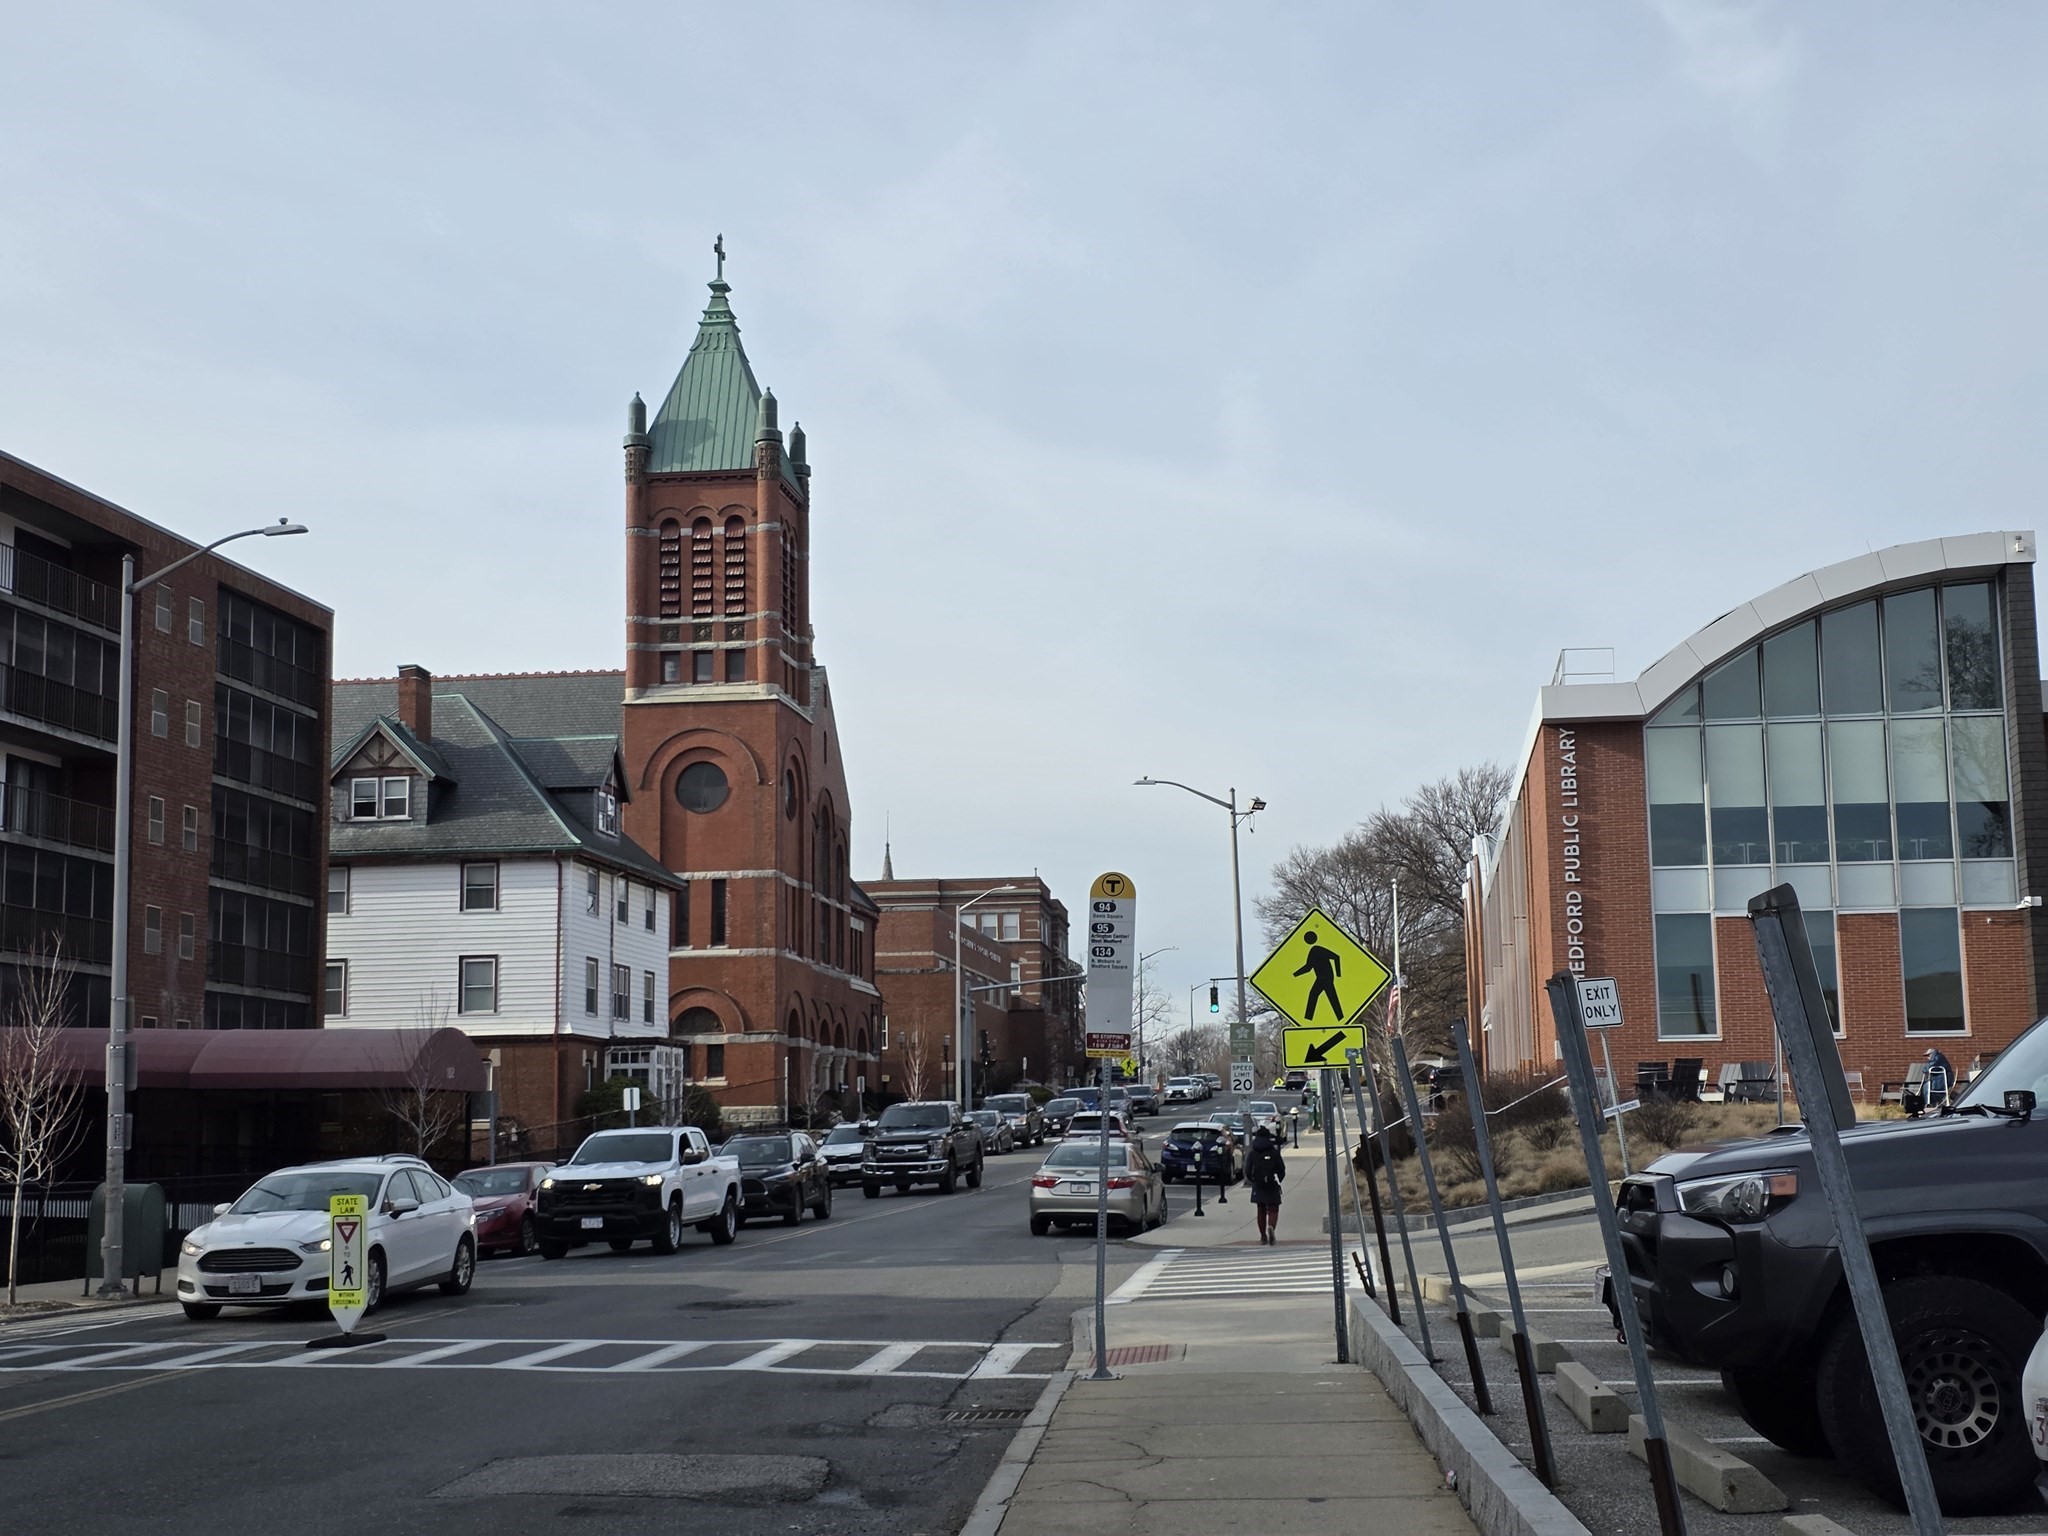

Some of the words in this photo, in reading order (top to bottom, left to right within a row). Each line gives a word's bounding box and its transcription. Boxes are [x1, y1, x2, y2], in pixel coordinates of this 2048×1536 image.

[1559, 727, 1578, 807] LIBRARY
[1562, 814, 1581, 882] PUBLIC
[1106, 880, 1120, 892] T
[1098, 903, 1111, 912] 94
[1097, 923, 1109, 933] 95
[1095, 947, 1111, 956] 134
[1586, 987, 1609, 1000] EXIT
[1586, 1005, 1616, 1018] ONLY
[1233, 1079, 1253, 1091] 20
[2036, 1416, 2048, 1446] 3
